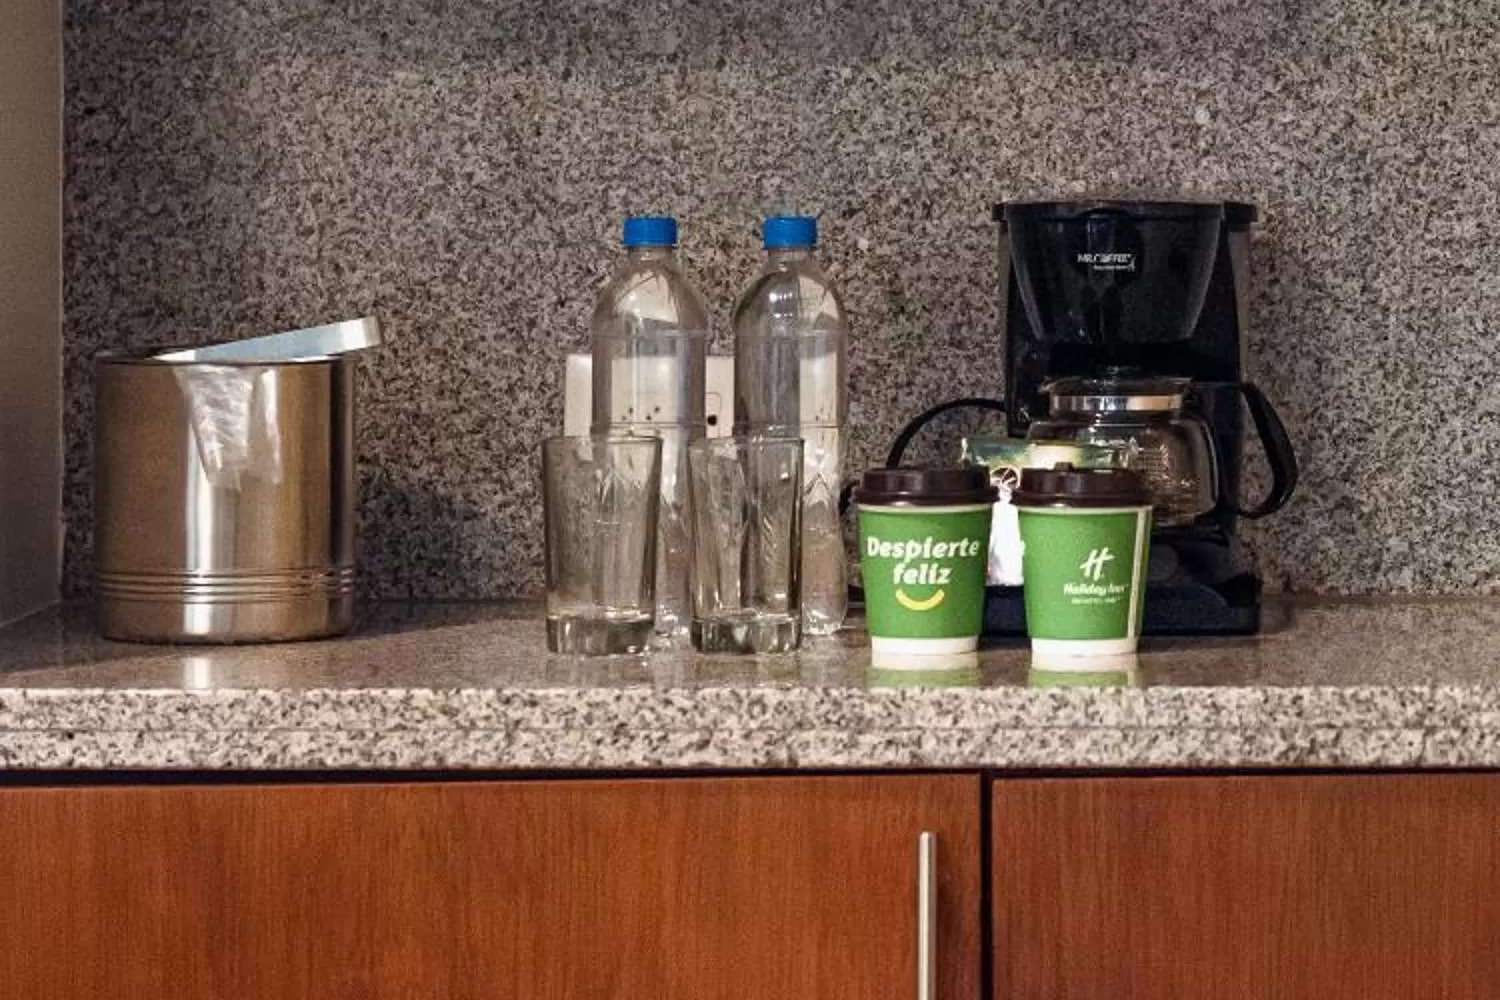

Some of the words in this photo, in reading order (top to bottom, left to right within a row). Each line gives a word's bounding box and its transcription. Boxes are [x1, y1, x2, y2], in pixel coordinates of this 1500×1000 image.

[867, 535, 980, 564] Despierte
[892, 562, 953, 585] feliz
[1063, 582, 1107, 598] Holiday
